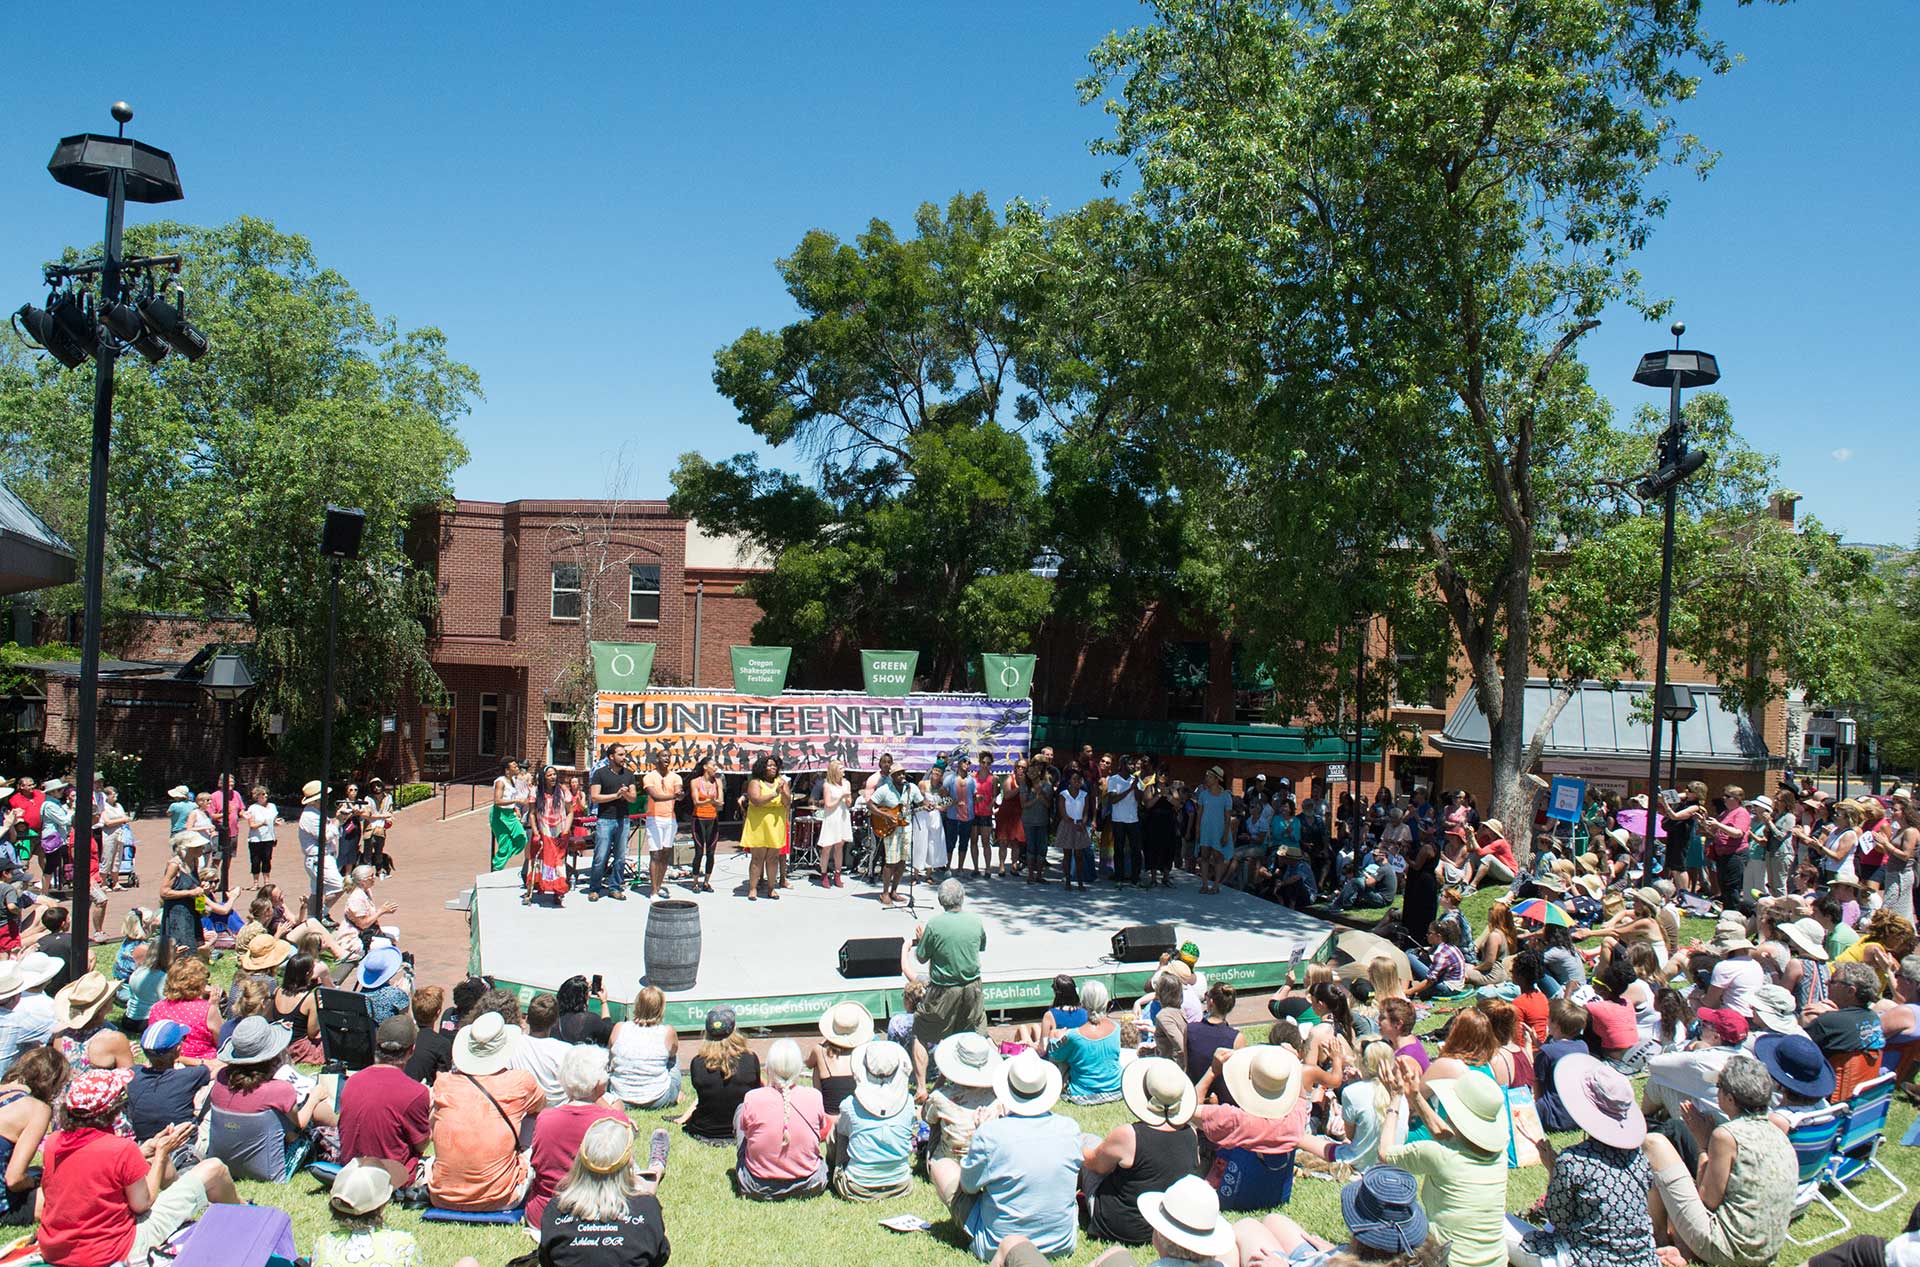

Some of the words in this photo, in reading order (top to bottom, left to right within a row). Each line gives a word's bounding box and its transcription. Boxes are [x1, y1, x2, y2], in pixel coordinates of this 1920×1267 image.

[748, 659, 774, 668] Oregon
[873, 661, 908, 670] GREEN
[739, 667, 781, 676] Shakespeare
[872, 674, 906, 683] SHOW
[603, 702, 924, 736] JUNETEENTH
[1206, 968, 1256, 981] reenShow
[983, 984, 1041, 1000] SFAshland
[577, 1223, 619, 1232] Celebration
